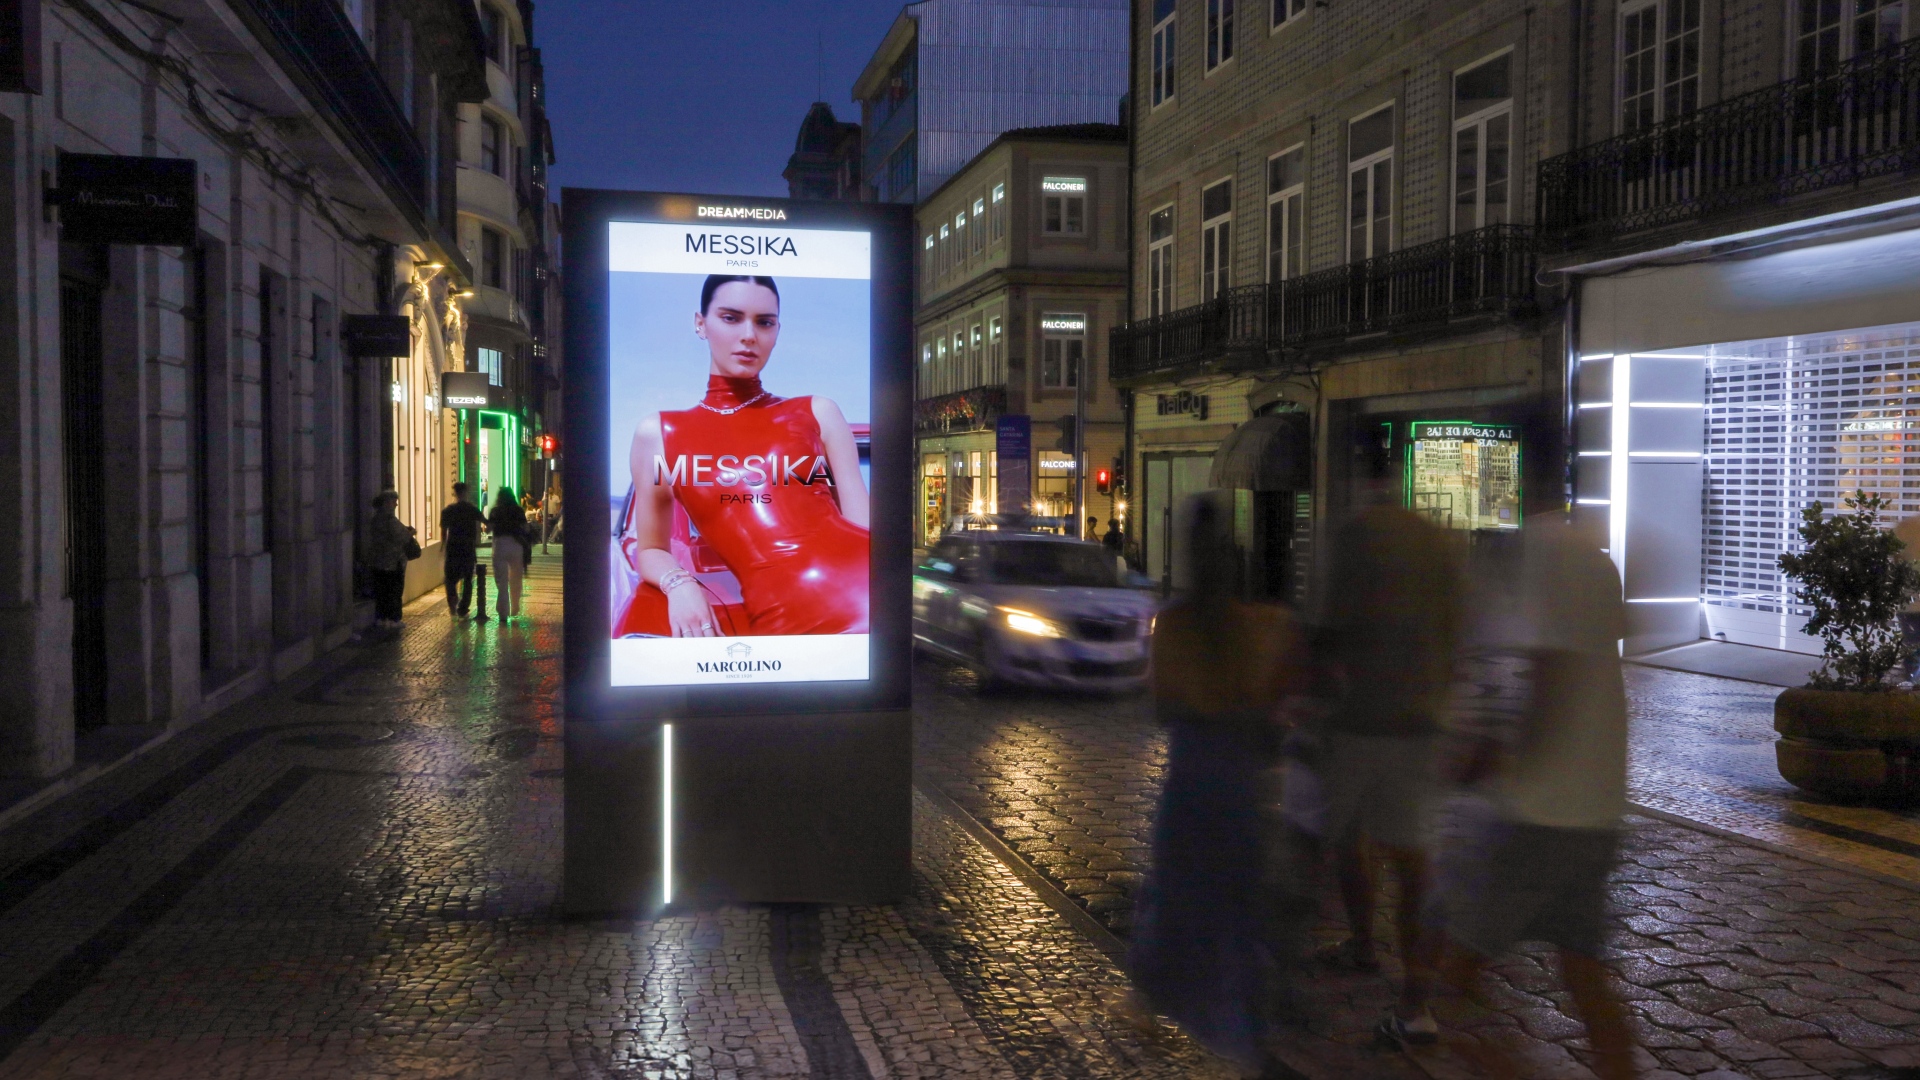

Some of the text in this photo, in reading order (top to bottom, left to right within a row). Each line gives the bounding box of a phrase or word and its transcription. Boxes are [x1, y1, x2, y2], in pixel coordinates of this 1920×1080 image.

[1042, 182, 1084, 191] FALCONERI
[685, 233, 798, 257] MESSIKA
[726, 259, 759, 268] PARIS
[1042, 320, 1084, 329] FALCONERI
[447, 395, 487, 405] TEZENIS
[652, 454, 836, 488] MESSIKA
[720, 492, 772, 506] PARIS
[696, 660, 782, 673] MARCOLINO
